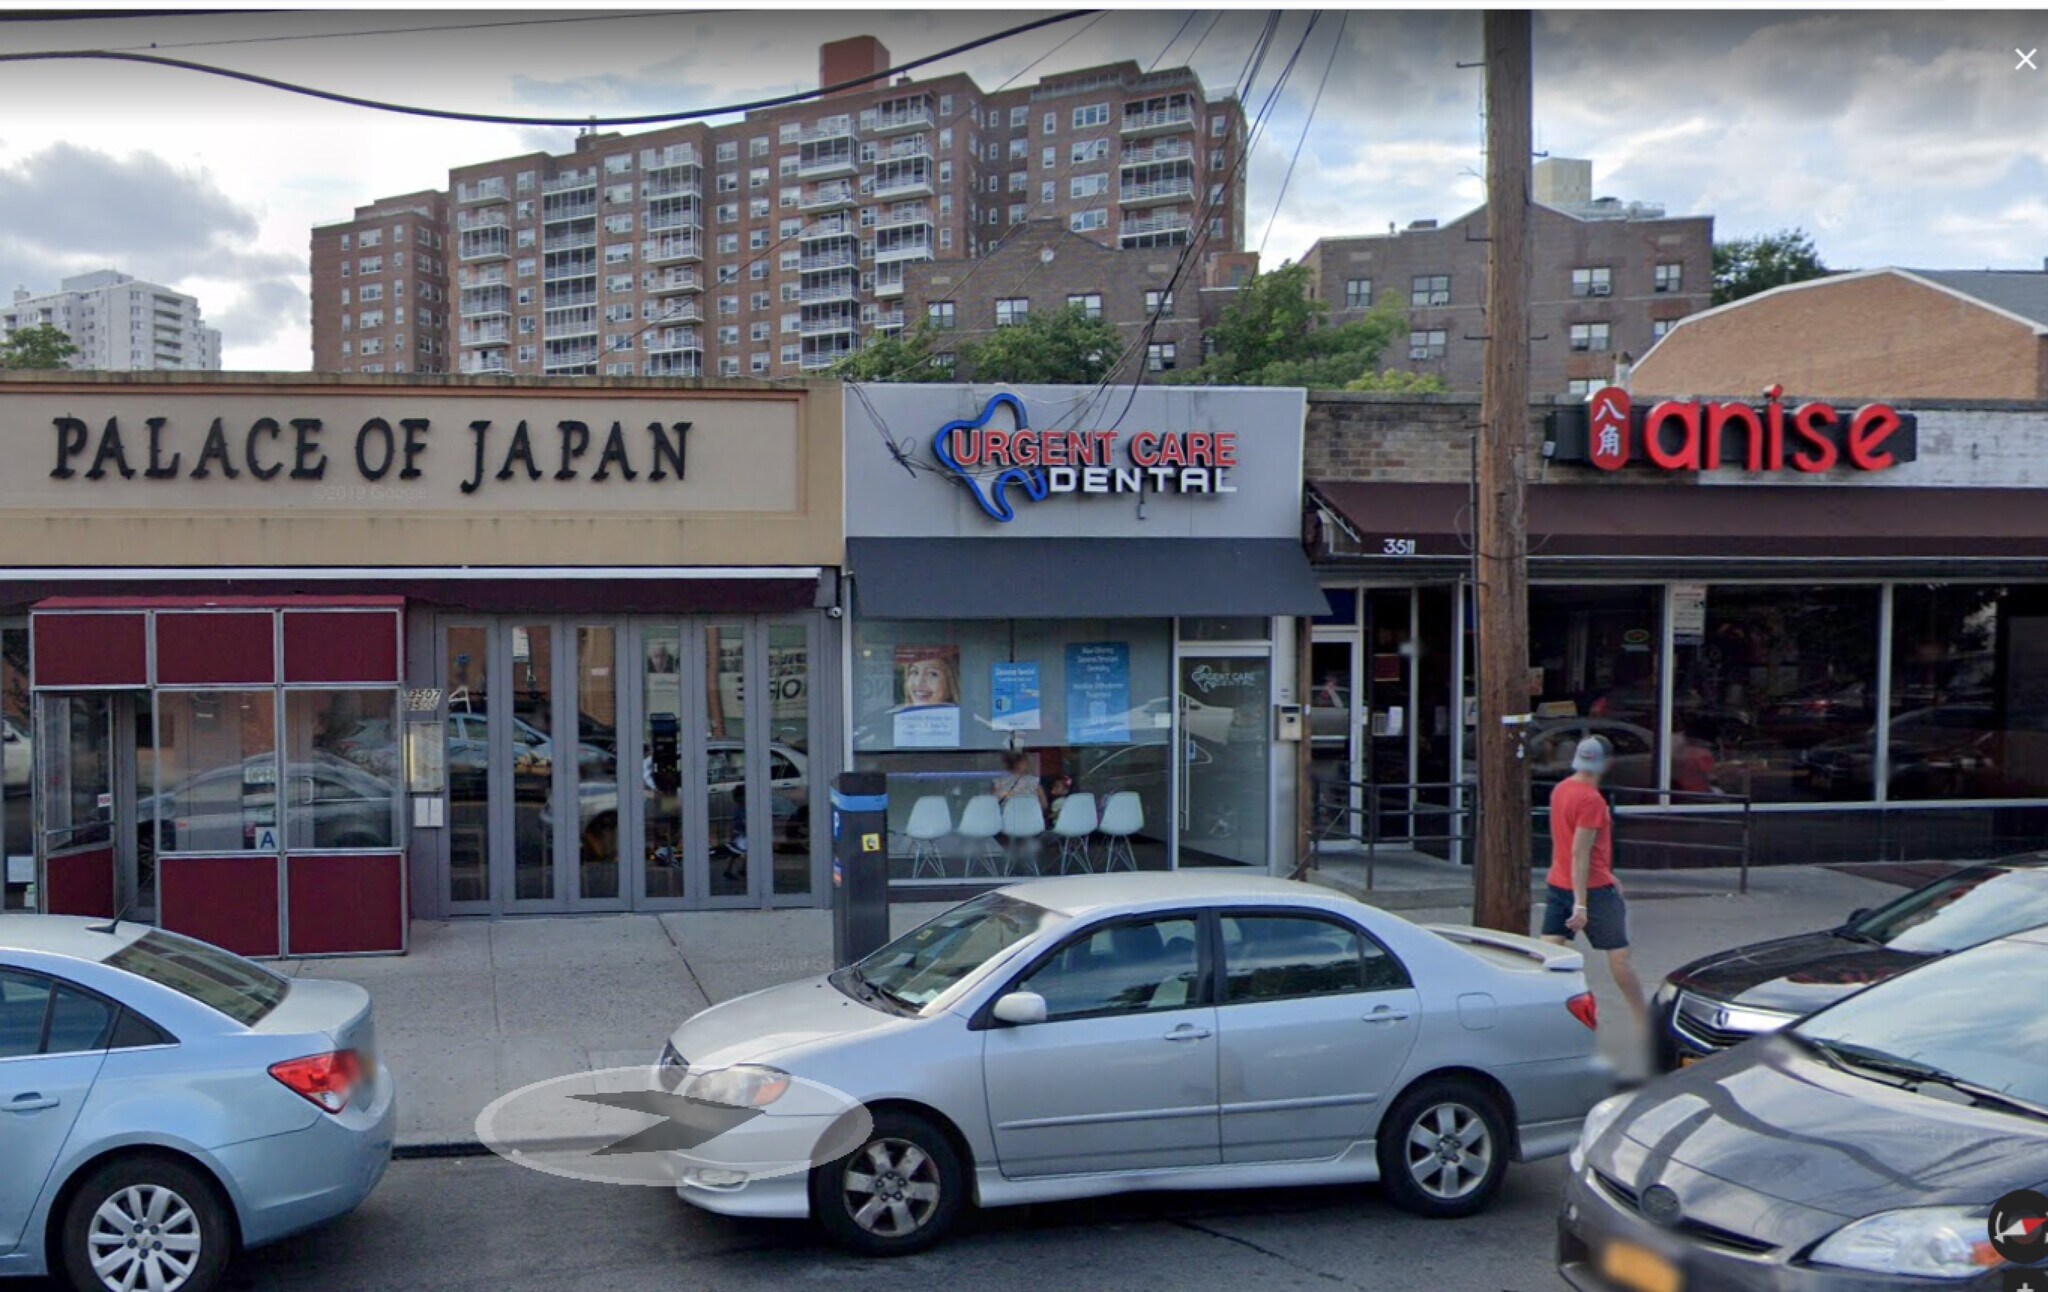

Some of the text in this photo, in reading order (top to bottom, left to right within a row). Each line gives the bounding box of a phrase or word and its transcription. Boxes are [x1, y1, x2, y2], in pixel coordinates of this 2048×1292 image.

[1594, 398, 1626, 457] 八角
[1644, 383, 1900, 473] anise
[49, 414, 693, 494] PALACE OF JAPAN
[953, 429, 1237, 467] URGENT CARE
[1050, 467, 1237, 493] DENTAL
[1384, 538, 1416, 555] 3511
[260, 832, 275, 849] A
